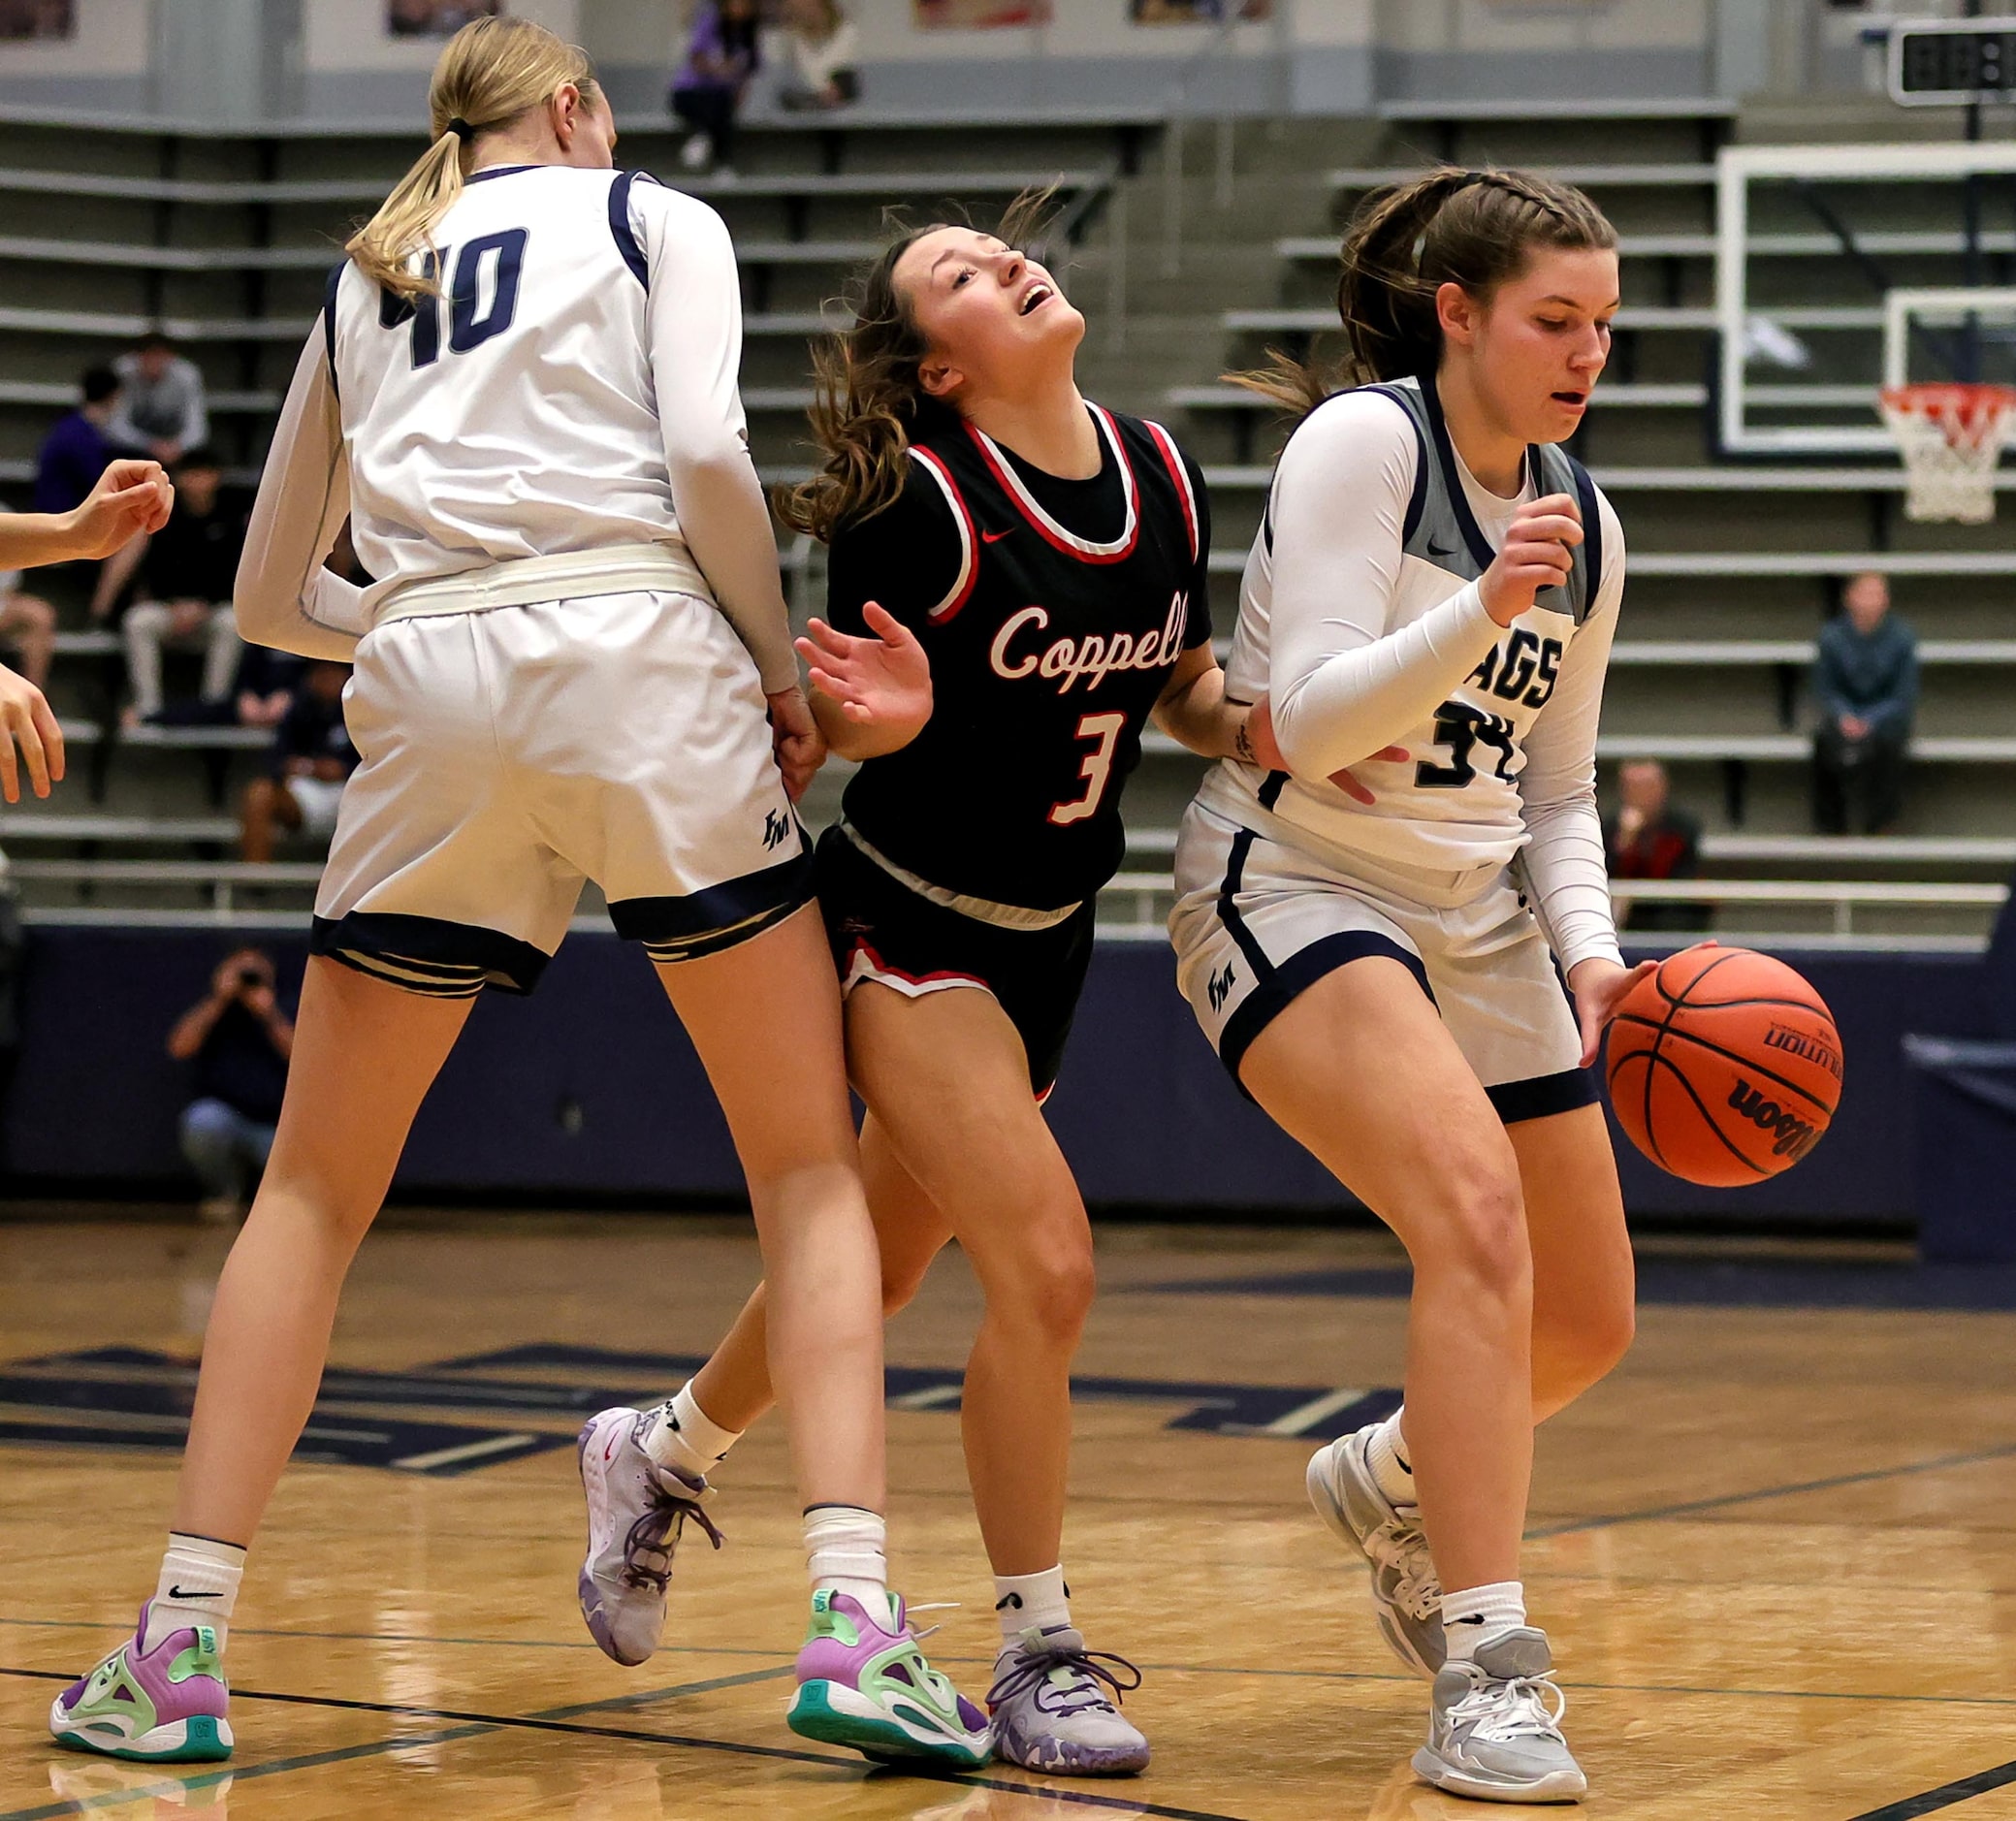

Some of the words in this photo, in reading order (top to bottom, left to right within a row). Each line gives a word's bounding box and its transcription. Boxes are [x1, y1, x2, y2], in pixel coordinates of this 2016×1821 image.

[989, 589, 1189, 694] Coppell
[1046, 710, 1127, 827] 3
[1414, 700, 1516, 788] 34
[761, 808, 790, 853] FM
